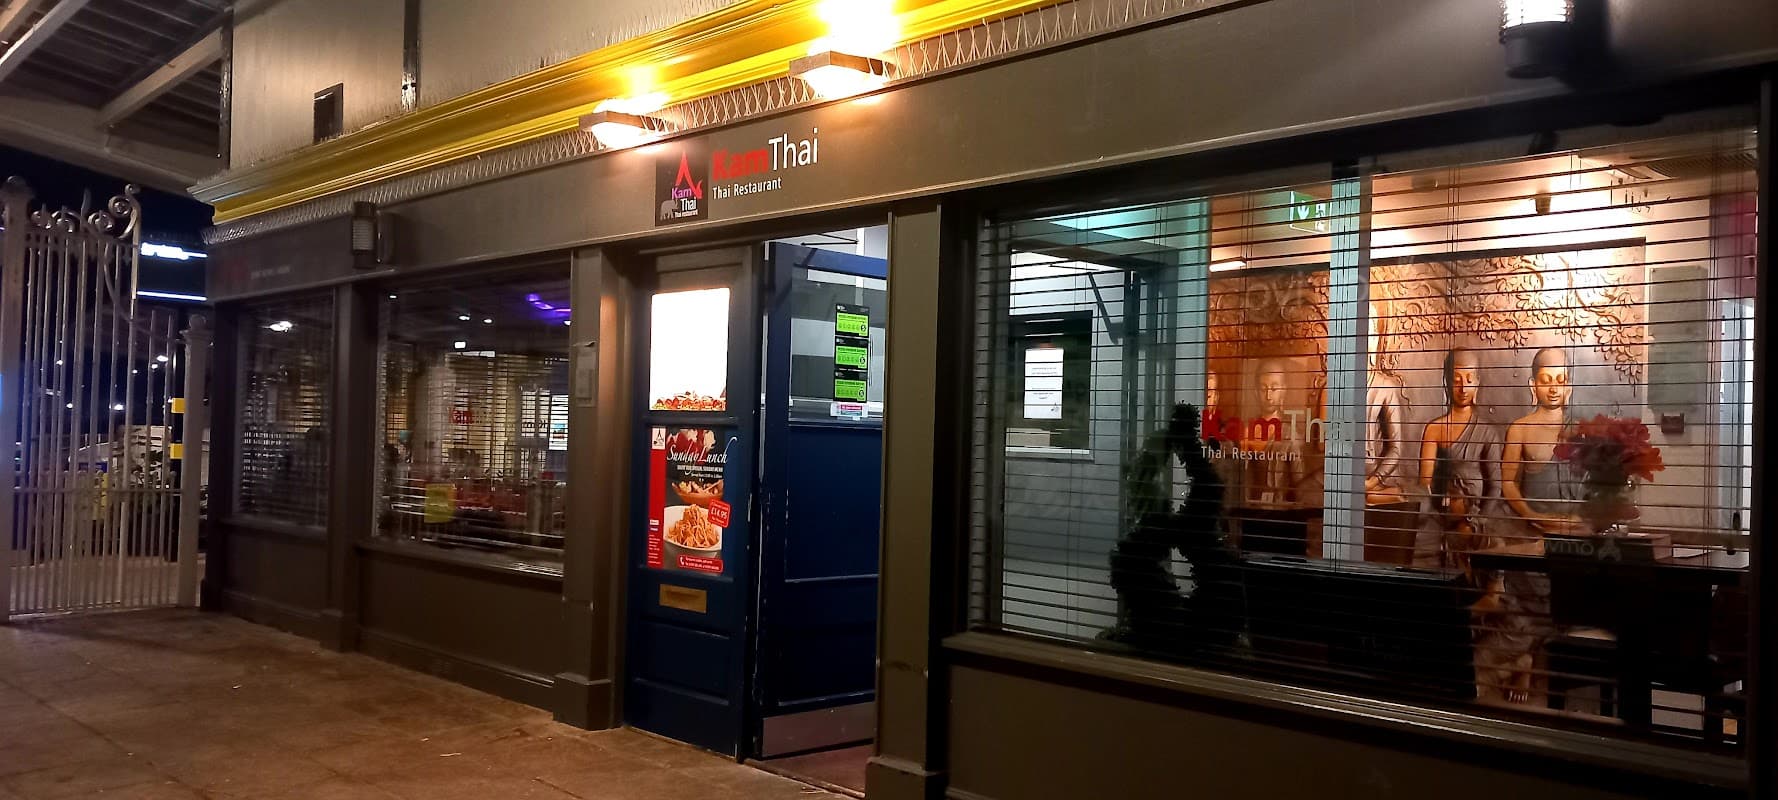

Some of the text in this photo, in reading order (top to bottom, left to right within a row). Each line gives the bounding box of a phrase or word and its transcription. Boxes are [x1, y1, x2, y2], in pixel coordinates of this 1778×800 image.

[671, 186, 692, 200] Kam
[712, 177, 783, 200] Thai Restaurant
[680, 195, 698, 212] Thai
[666, 437, 738, 471] Sunday Lunch
[1200, 446, 1302, 463] Thai Restaurant
